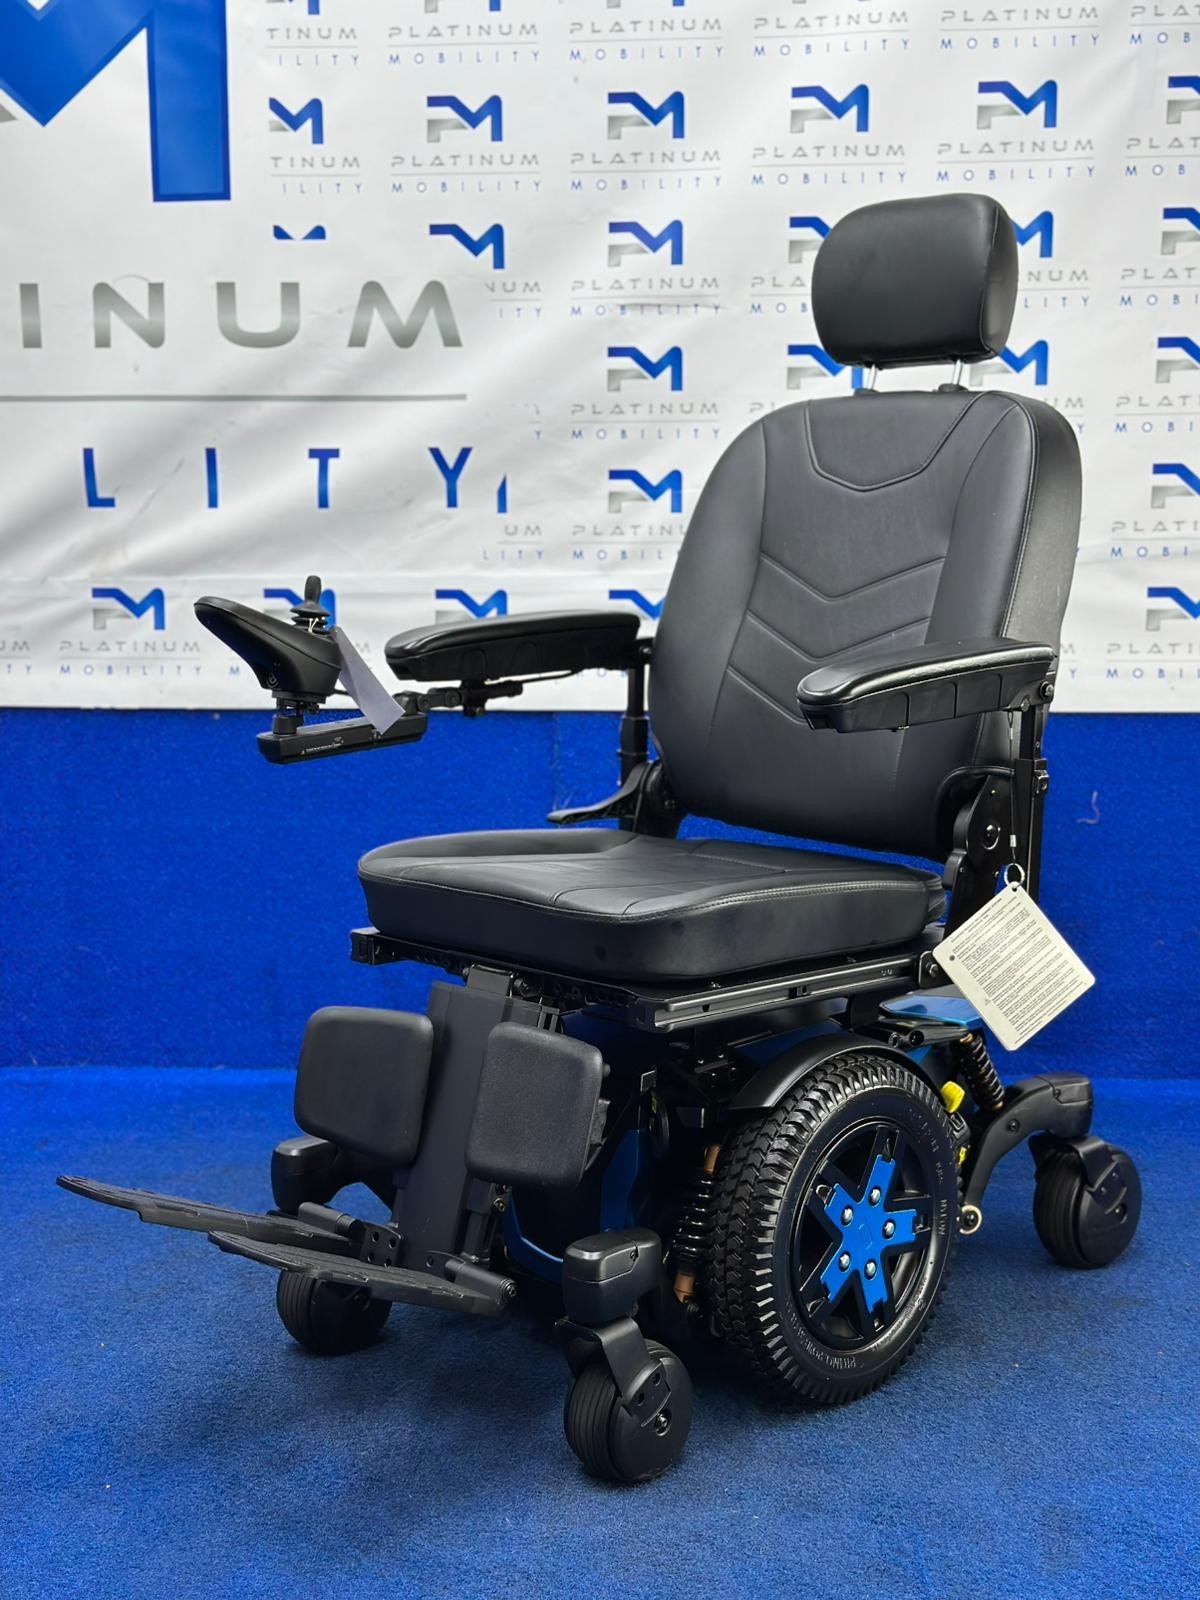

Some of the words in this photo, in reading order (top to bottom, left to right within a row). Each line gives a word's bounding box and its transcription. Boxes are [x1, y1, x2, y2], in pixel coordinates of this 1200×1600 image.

[754, 11, 909, 30] PLATINUM
[941, 6, 1099, 22] PLATINUM
[388, 24, 539, 39] PLATINUM
[569, 18, 722, 34] PLATINUM
[754, 39, 910, 57] MOBILITY
[940, 33, 1100, 50] MOBILITY
[388, 51, 540, 65] MOBILITY
[569, 46, 724, 61] MOBILITY
[752, 144, 906, 159] PLATINUM
[937, 139, 1095, 155] PLATINUM
[391, 154, 540, 168] PLATINUM
[570, 150, 721, 165] PLATINUM
[752, 172, 906, 187] MOBILITY
[936, 165, 1096, 182] MOBILITY
[392, 181, 541, 194] MOBILITY
[570, 176, 722, 192] MOBILITY
[571, 277, 719, 291] PLATINUM
[570, 305, 721, 317] MOBILITY
[571, 403, 719, 416] PLATINUM
[570, 428, 721, 440] MOBILITY
[59, 640, 201, 653] PLATINUM
[59, 664, 203, 677] MOBILITY
